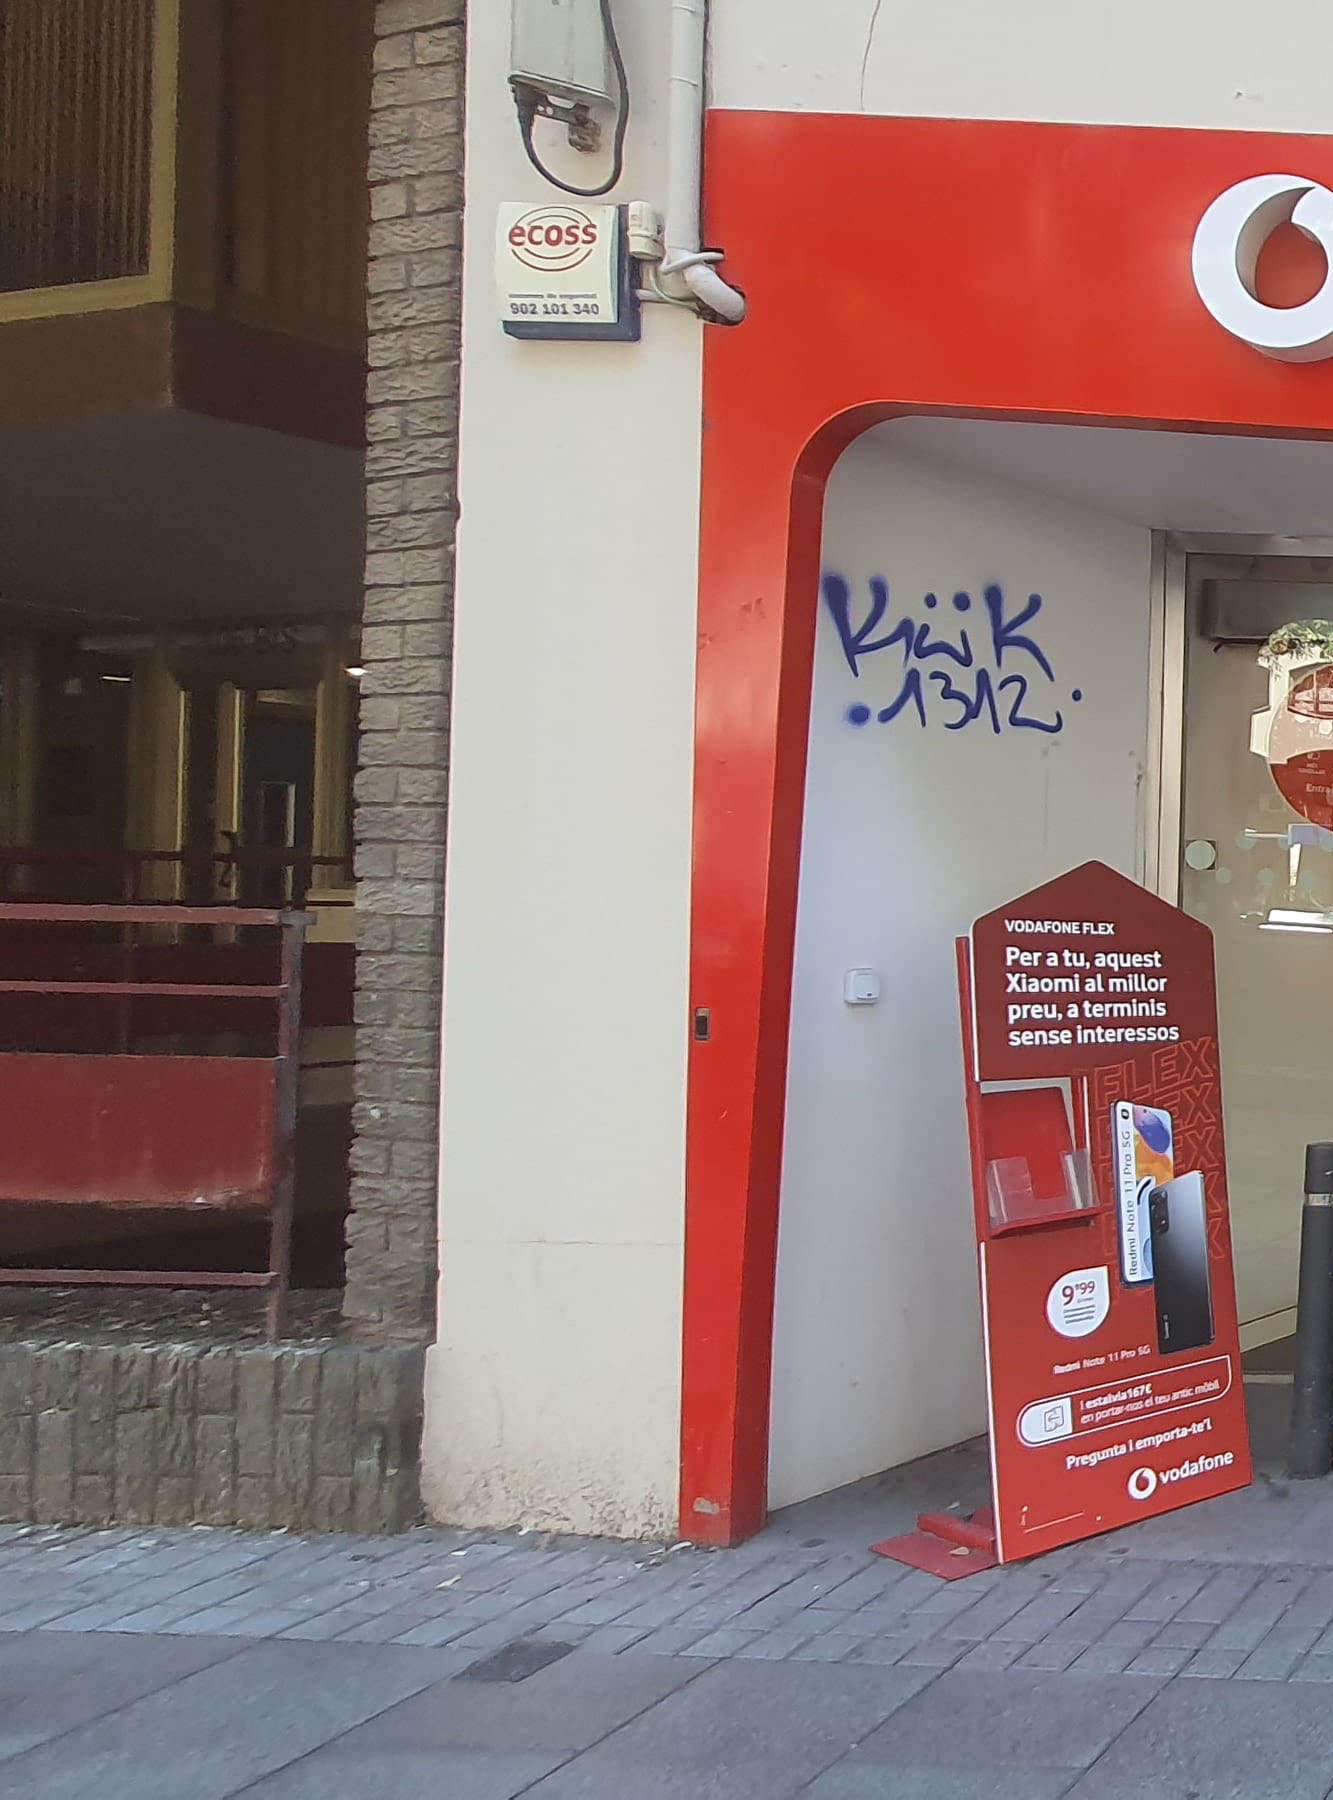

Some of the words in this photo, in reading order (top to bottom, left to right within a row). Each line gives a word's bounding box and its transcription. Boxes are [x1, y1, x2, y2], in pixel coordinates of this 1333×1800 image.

[508, 223, 597, 247] ecoss
[510, 302, 538, 315] 902
[542, 303, 569, 315] 101
[573, 303, 600, 315] 340
[1005, 919, 1081, 934] VODAFONE
[1082, 923, 1115, 935] FLEX
[1005, 947, 1042, 967] Per
[1046, 952, 1059, 967] a
[1062, 949, 1091, 970] tu,
[1094, 951, 1162, 972] aquest
[1005, 973, 1080, 993] Xiaomi
[1084, 974, 1105, 993] al
[1108, 974, 1168, 993] millor
[1008, 1002, 1063, 1025] preu,
[1067, 1003, 1079, 1018] a
[1082, 998, 1167, 1018] terminis
[1008, 1029, 1073, 1047] sense
[1076, 1025, 1180, 1044] interessos
[1094, 1036, 1214, 1111] FLEX
[1123, 1153, 1132, 1176] Pro
[1127, 1200, 1135, 1232] Note
[1128, 1238, 1138, 1276] Redmi
[1081, 1413, 1094, 1424] en
[1066, 1444, 1127, 1470] Pregunta
[1135, 1417, 1212, 1450] emporta-te'l
[1159, 1451, 1234, 1484] vodafone
